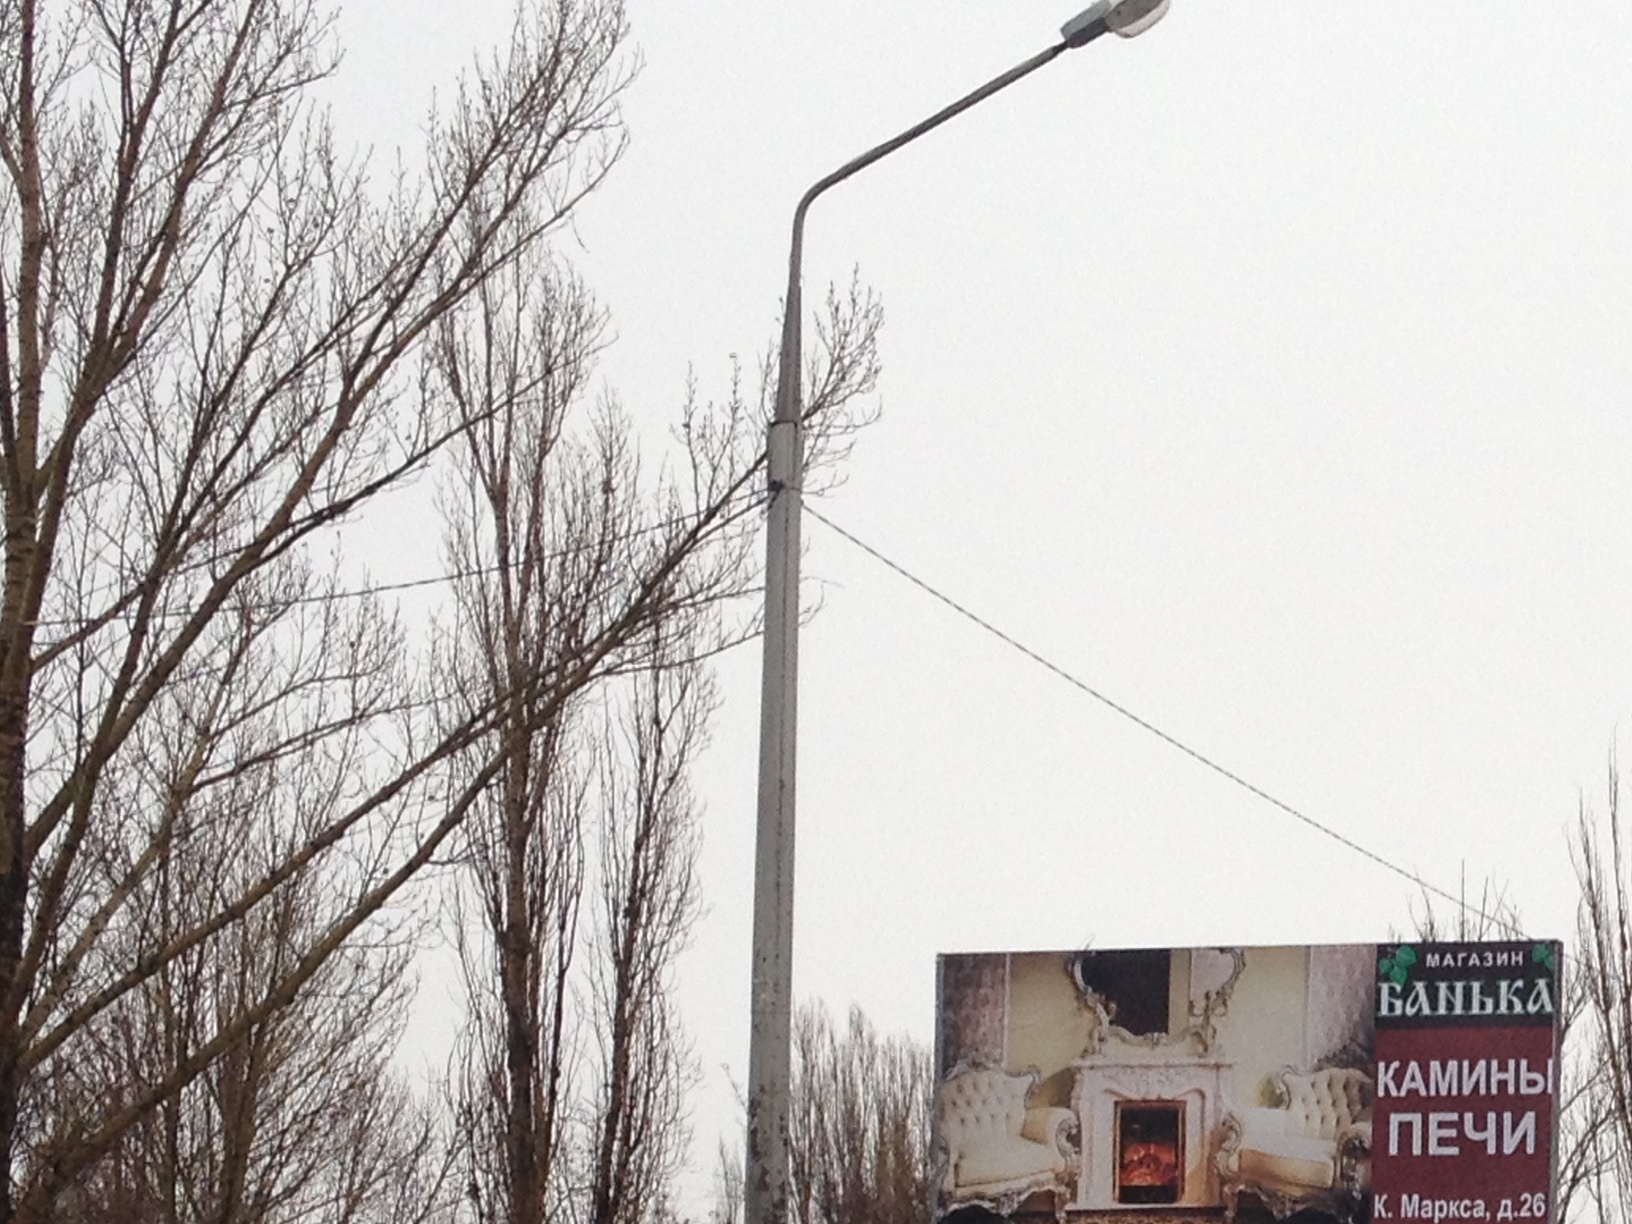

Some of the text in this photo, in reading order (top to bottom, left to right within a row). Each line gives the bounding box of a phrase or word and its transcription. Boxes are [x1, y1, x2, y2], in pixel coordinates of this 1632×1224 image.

[1426, 952, 1523, 967] МАГАЗИН
[1378, 978, 1554, 1017] БАНЬКА
[1377, 1059, 1553, 1097] КАМИНЫ
[1389, 1111, 1536, 1156] ПЕЧИ
[1374, 1192, 1546, 1224] К. Маркса, д.26
